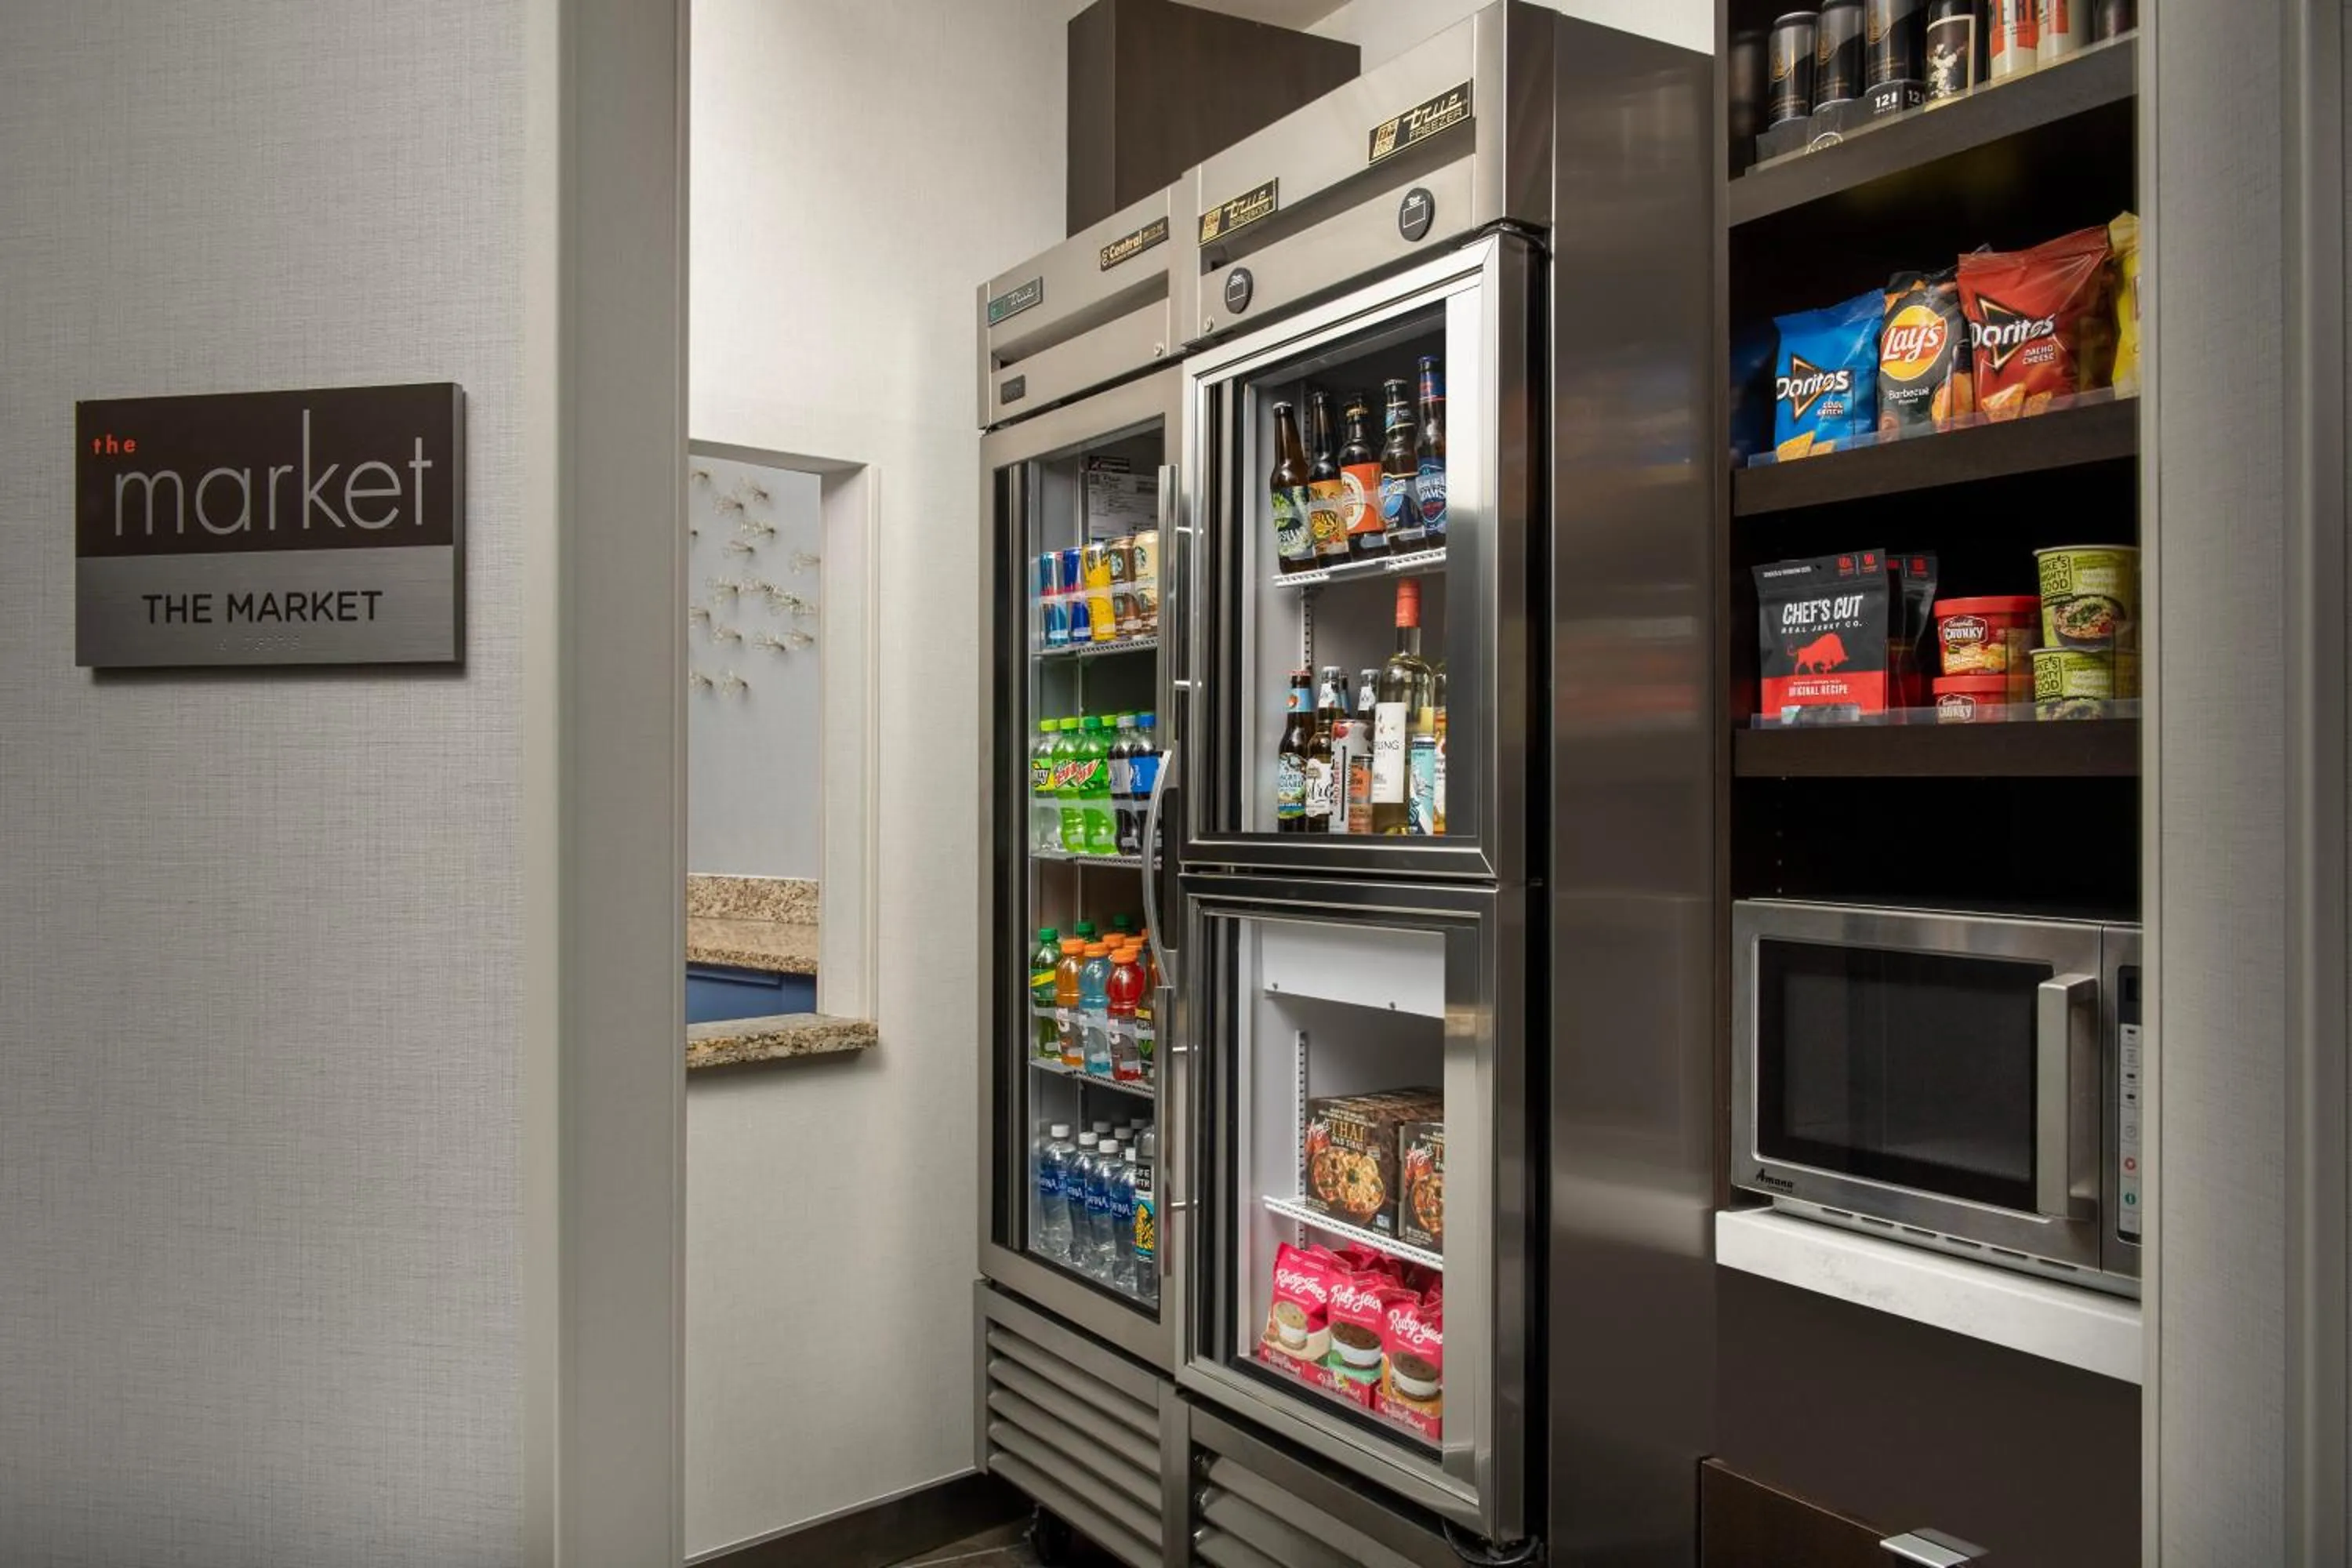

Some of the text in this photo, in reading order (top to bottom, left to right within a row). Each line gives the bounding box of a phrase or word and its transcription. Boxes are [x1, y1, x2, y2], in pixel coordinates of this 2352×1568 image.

[1409, 107, 1462, 141] FREEZER
[1969, 314, 2056, 349] Doritos
[2022, 354, 2054, 365] CHEESE
[2025, 344, 2053, 356] NACHO
[1776, 371, 1849, 401] Doritos
[1889, 387, 1929, 400] Barbecue
[92, 435, 137, 455] the
[115, 408, 433, 536] market
[142, 590, 383, 624] THE MARKET
[1782, 595, 1864, 625] CHEF'S CUT
[1812, 622, 1840, 632] JERKY
[1946, 627, 1984, 640] CHUNKY
[1821, 683, 1849, 695] RECIPE
[1330, 1120, 1365, 1142] THAI
[1755, 1167, 1793, 1189] Amana
[1275, 1268, 1305, 1290] Ruby
[1330, 1283, 1358, 1309] Ruby
[1387, 1308, 1420, 1338] Ruby
